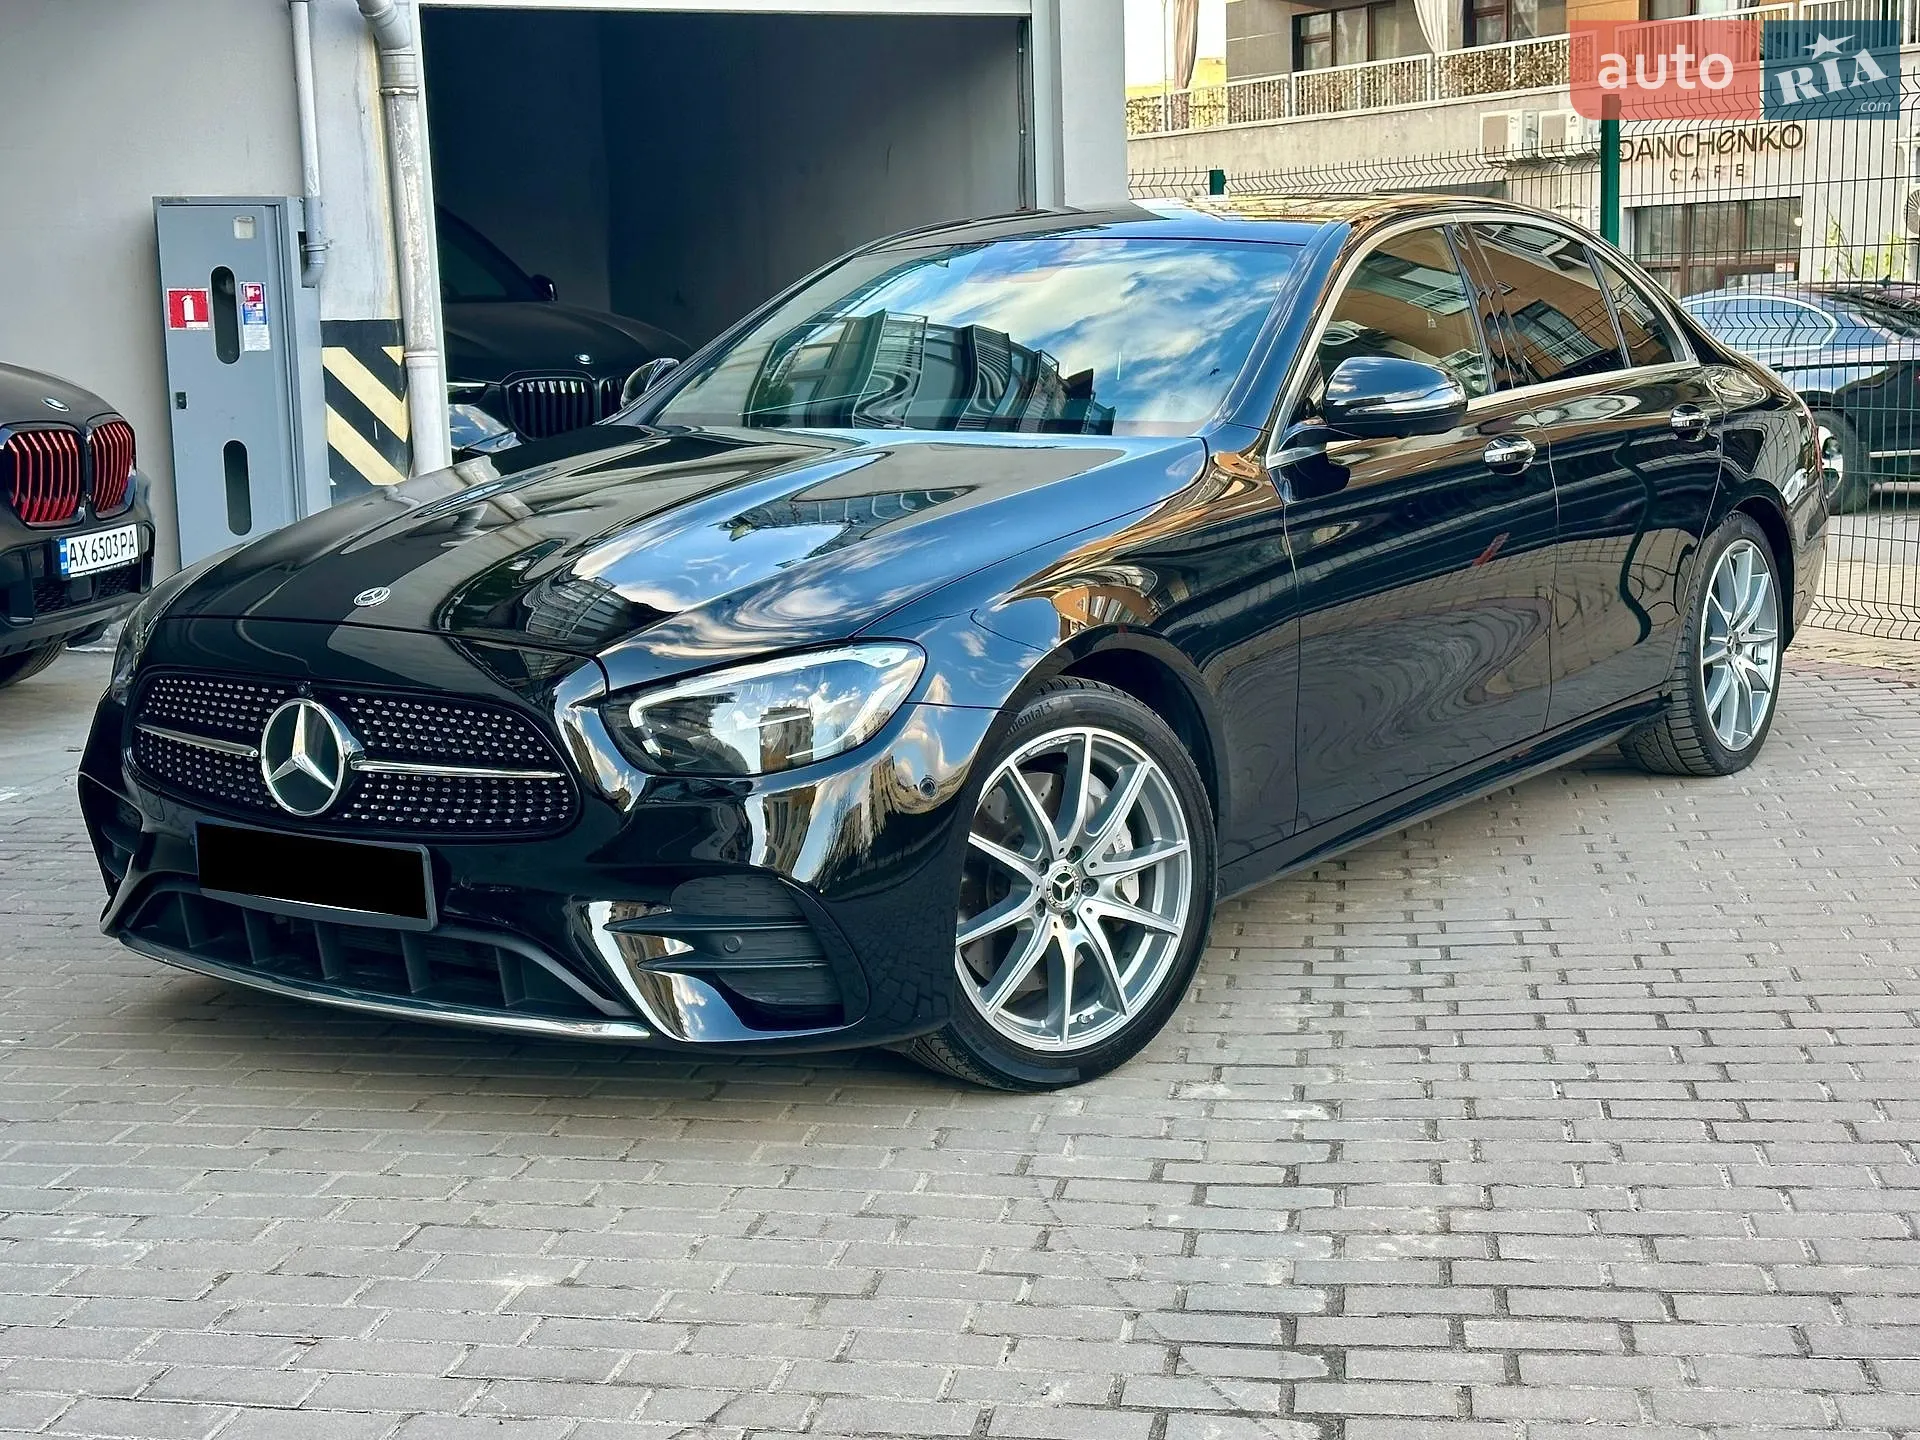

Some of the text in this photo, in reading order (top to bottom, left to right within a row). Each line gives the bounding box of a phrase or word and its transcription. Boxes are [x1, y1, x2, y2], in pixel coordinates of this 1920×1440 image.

[1669, 163, 1744, 182] CAFE
[69, 540, 89, 568] AX
[91, 533, 119, 563] 6503
[120, 530, 136, 557] PA
